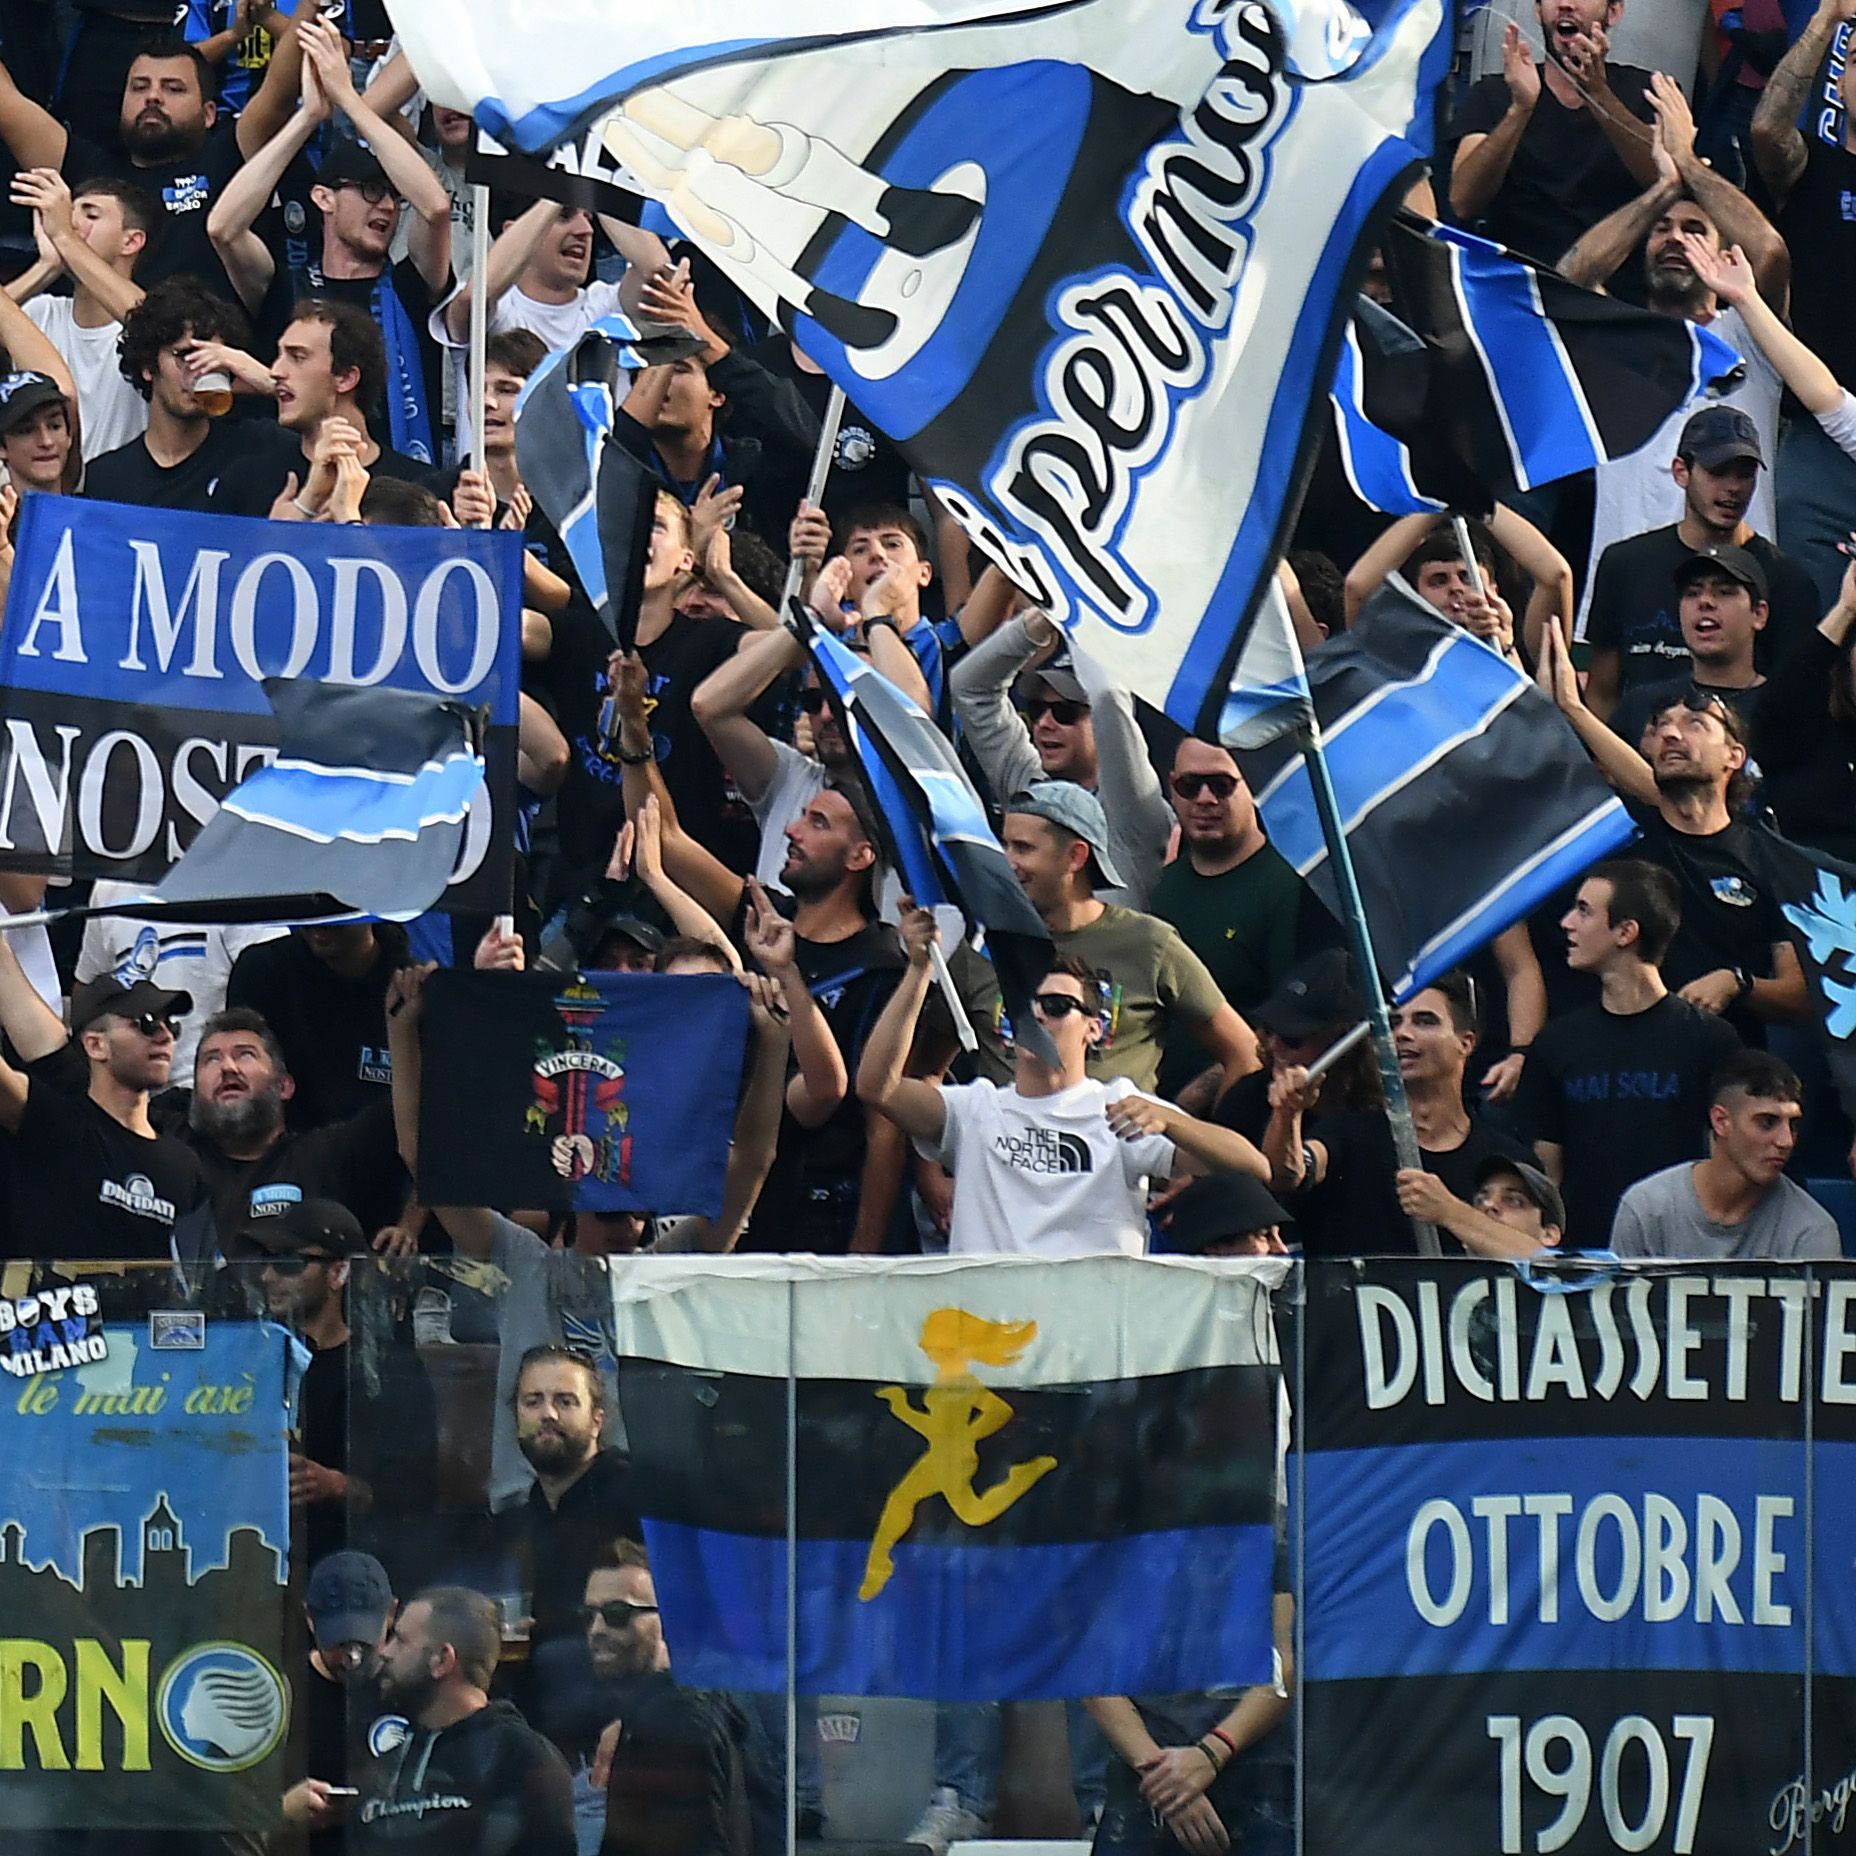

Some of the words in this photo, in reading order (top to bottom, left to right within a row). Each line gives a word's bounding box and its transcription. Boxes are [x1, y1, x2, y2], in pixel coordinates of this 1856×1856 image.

[16, 526, 90, 664] A
[115, 538, 502, 696] MODO
[996, 1136, 1059, 1160] NORTH
[1008, 1152, 1059, 1175] FACE
[1024, 1126, 1059, 1145] THE
[1405, 1492, 1796, 1628] OTTOBRE
[1486, 1712, 1716, 1856] 1907
